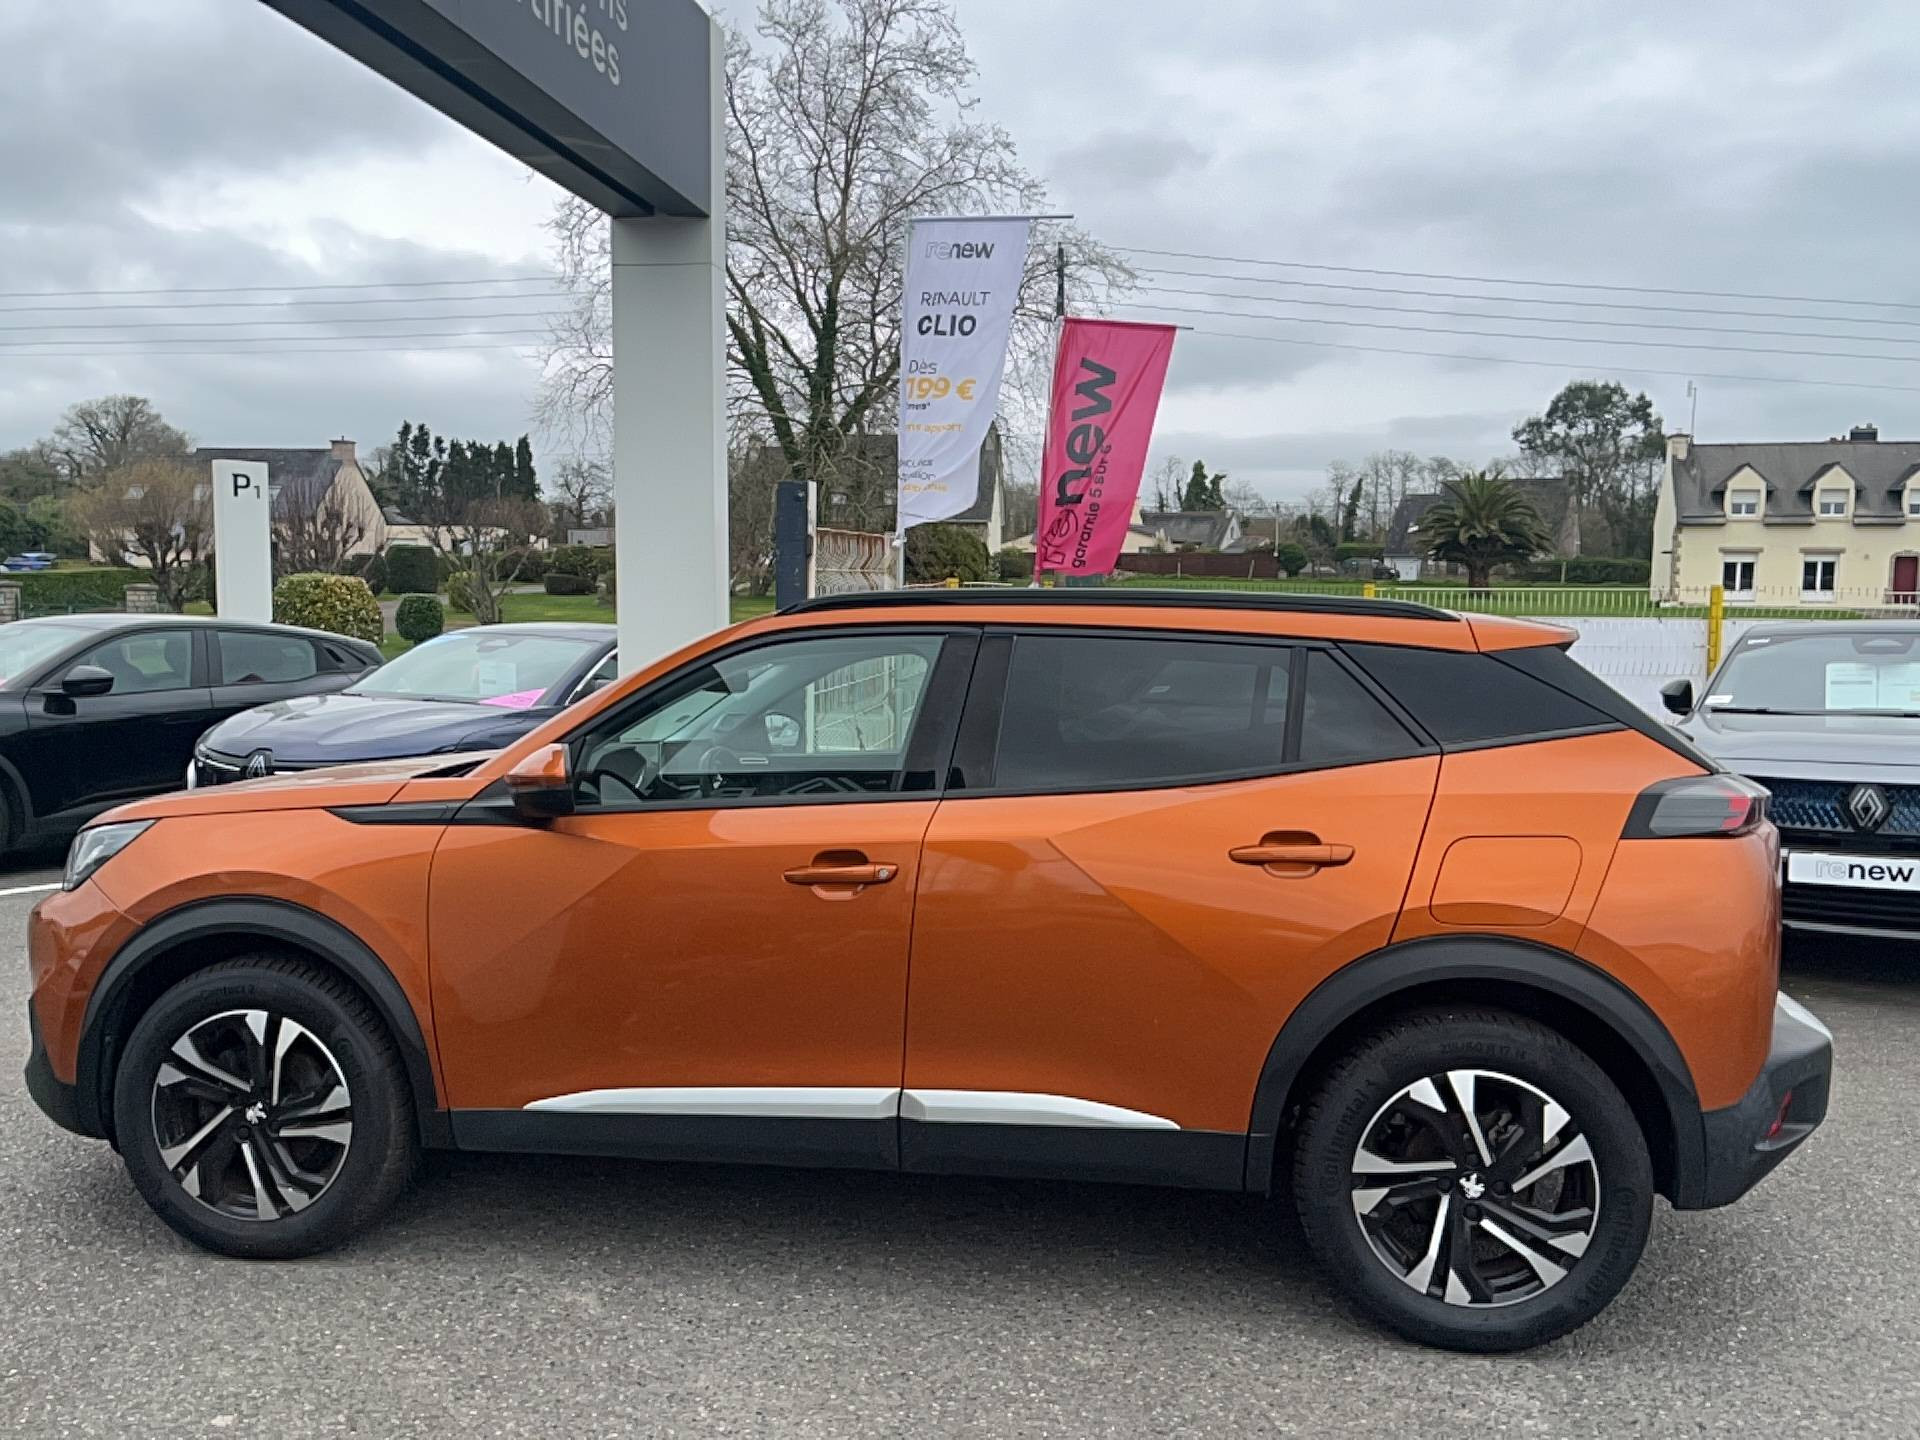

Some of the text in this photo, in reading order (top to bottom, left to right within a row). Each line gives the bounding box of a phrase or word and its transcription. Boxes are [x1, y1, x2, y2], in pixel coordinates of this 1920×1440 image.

[925, 241, 995, 260] renew
[917, 314, 977, 337] CLIO
[909, 359, 938, 376] Dès
[906, 377, 977, 401] 199 €
[1042, 358, 1117, 563] renew
[1815, 860, 1915, 882] renew
